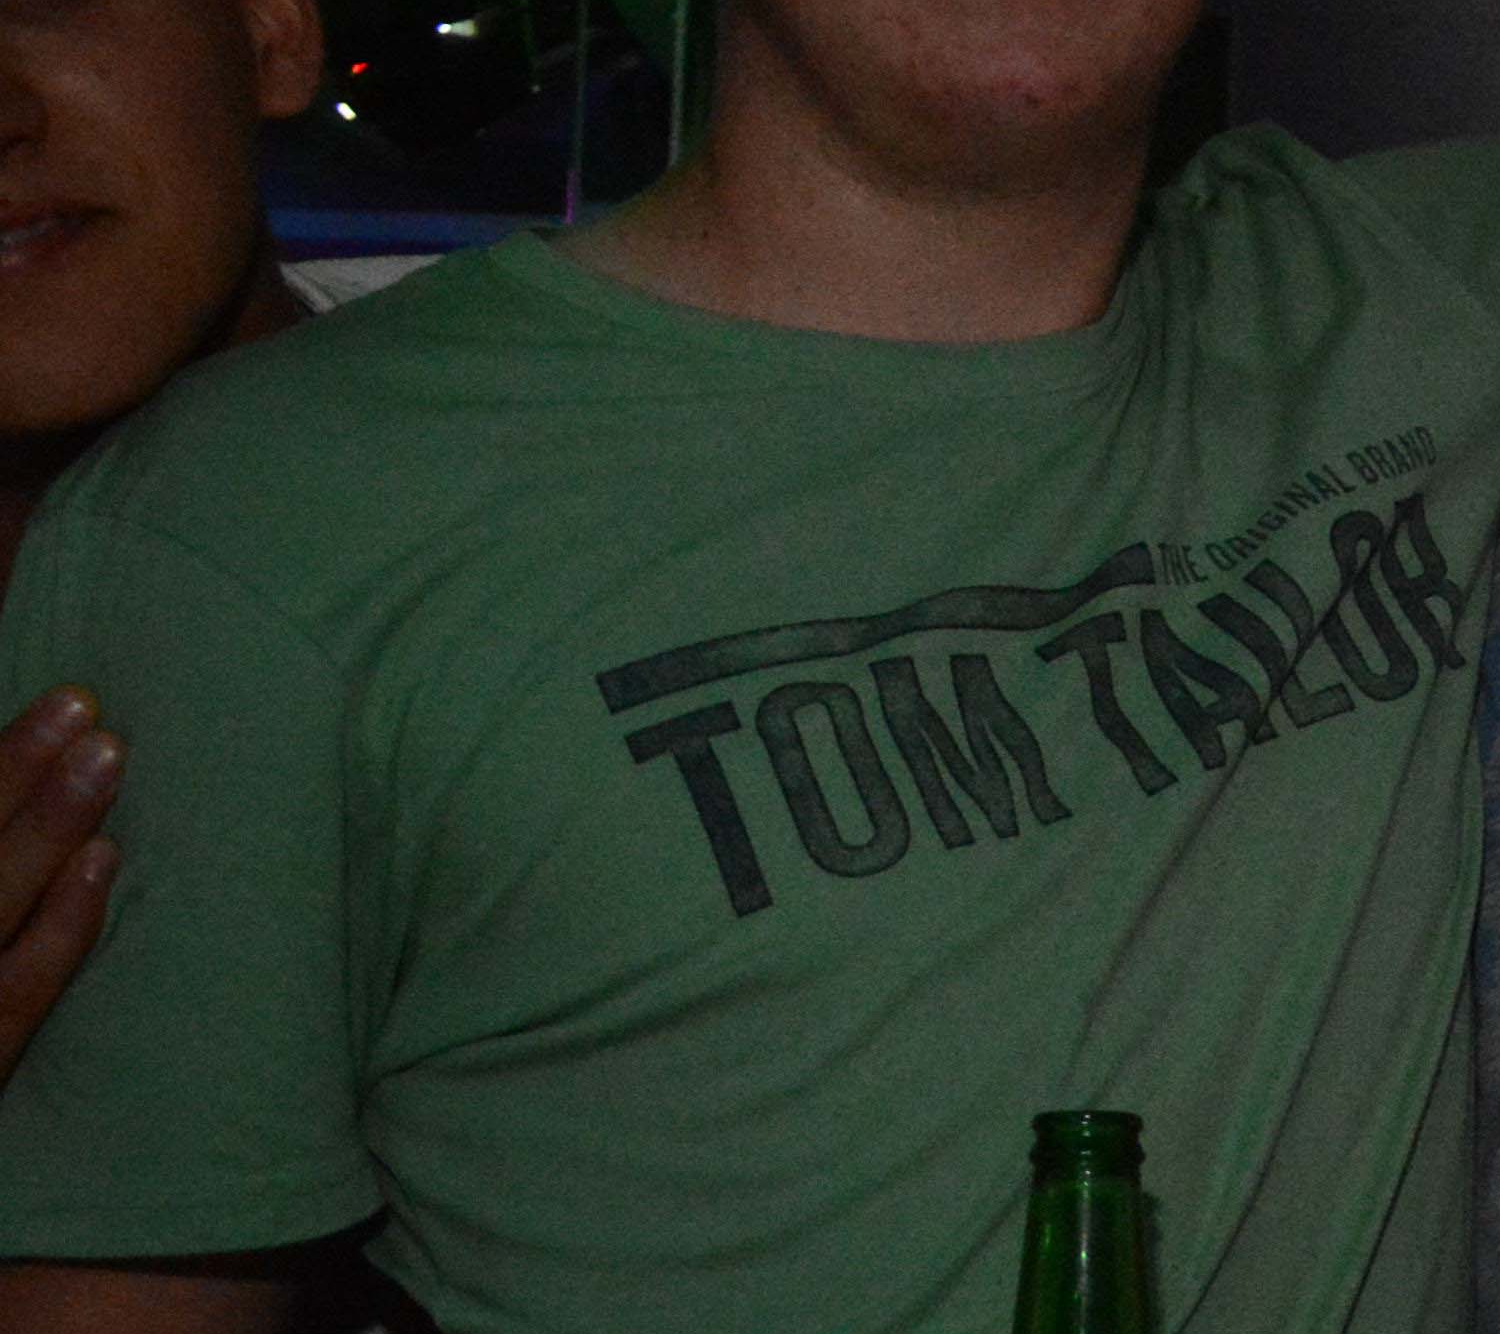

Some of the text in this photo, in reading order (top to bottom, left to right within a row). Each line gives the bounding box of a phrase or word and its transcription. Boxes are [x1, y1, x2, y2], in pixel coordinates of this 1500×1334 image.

[1157, 425, 1438, 585] THE ORIGINAL BRAND
[625, 493, 1468, 918] TOM TAILOR
